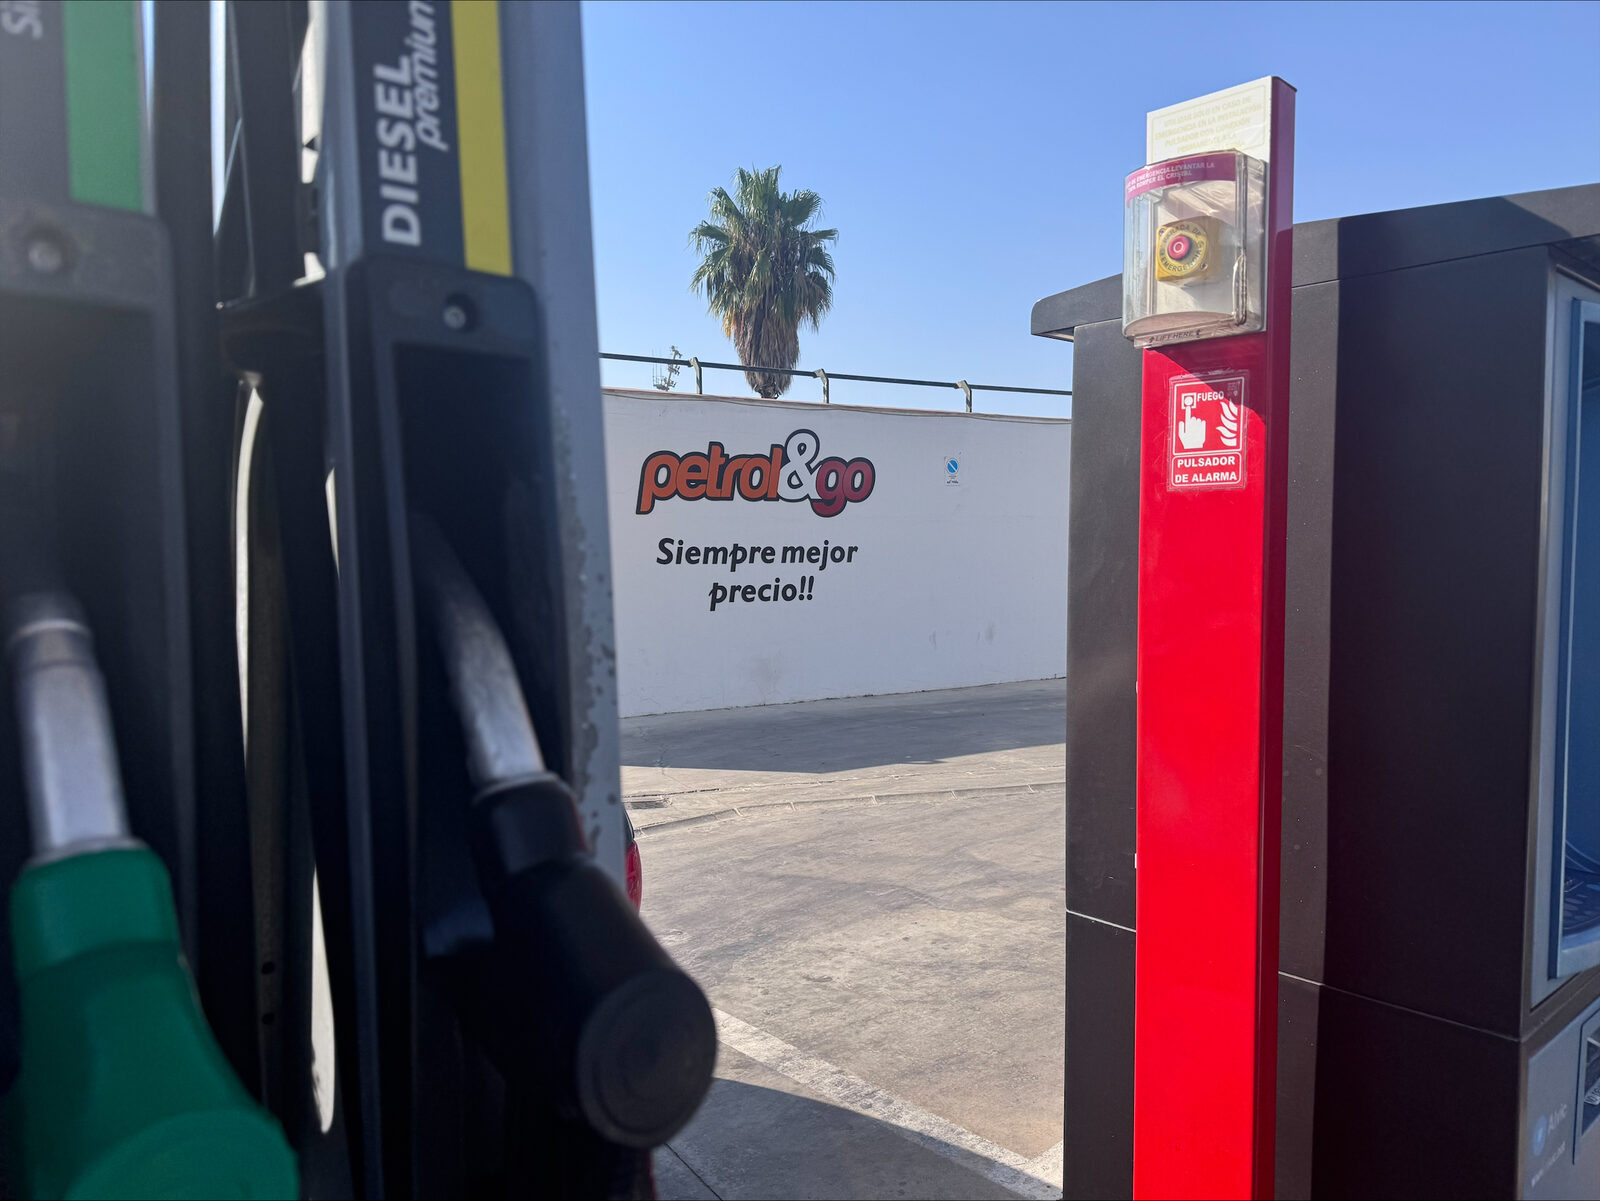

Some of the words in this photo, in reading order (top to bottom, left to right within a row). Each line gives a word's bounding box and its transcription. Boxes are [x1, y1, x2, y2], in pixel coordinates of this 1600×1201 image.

[1, 0, 42, 39] Si
[373, 55, 421, 246] DIESEL
[1172, 331, 1194, 340] HERE
[1197, 391, 1224, 402] FUEGO
[1177, 456, 1236, 468] PULSADOR
[1175, 474, 1189, 483] DE
[1191, 471, 1238, 483] ALARMA
[656, 538, 776, 572] Siempre
[781, 540, 859, 571] mejor
[708, 575, 815, 612] precio!!
